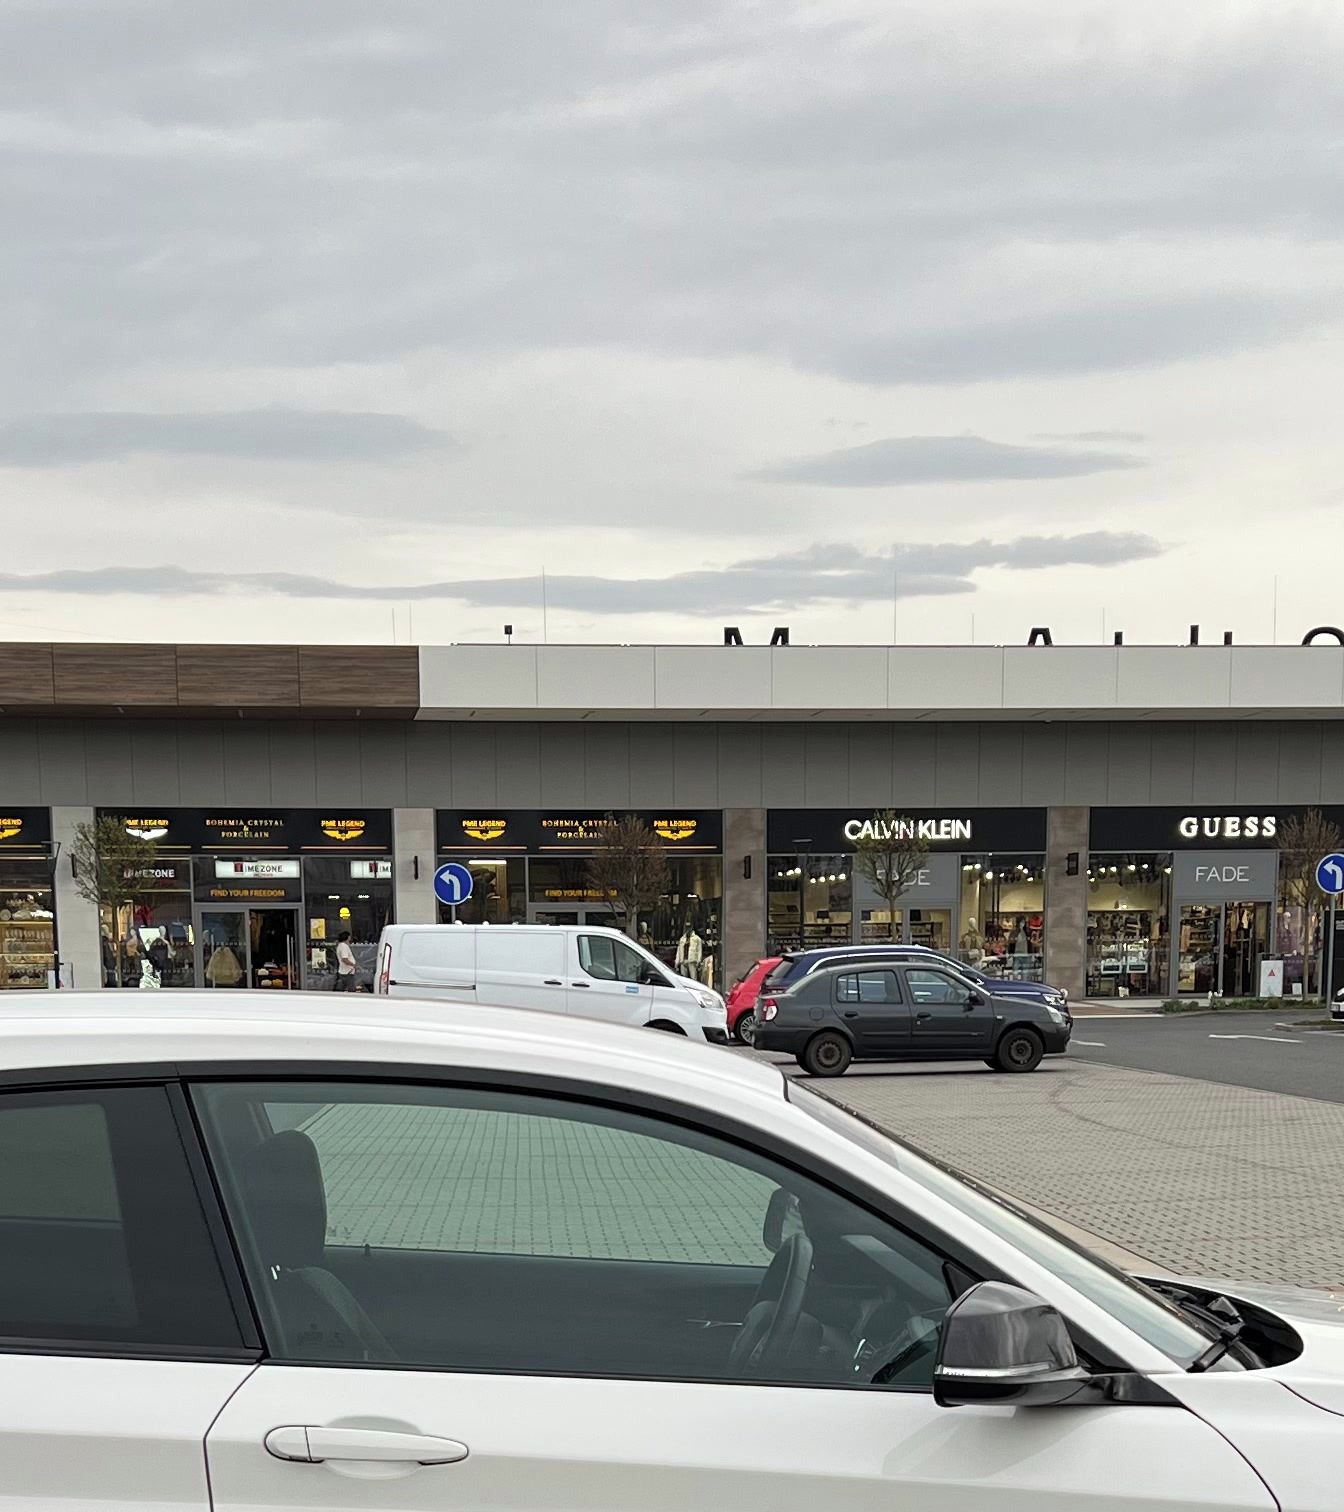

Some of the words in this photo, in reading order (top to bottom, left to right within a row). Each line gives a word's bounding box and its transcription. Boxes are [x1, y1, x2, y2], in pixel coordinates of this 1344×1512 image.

[542, 819, 579, 827] BOHEMIA
[844, 819, 915, 840] CALVIN
[918, 819, 971, 839] KLEIN
[1179, 816, 1276, 838] GUESS
[1194, 865, 1250, 883] FADE
[210, 888, 228, 897] FIND
[228, 888, 249, 897] YOUR
[249, 888, 285, 897] FREEDOM
